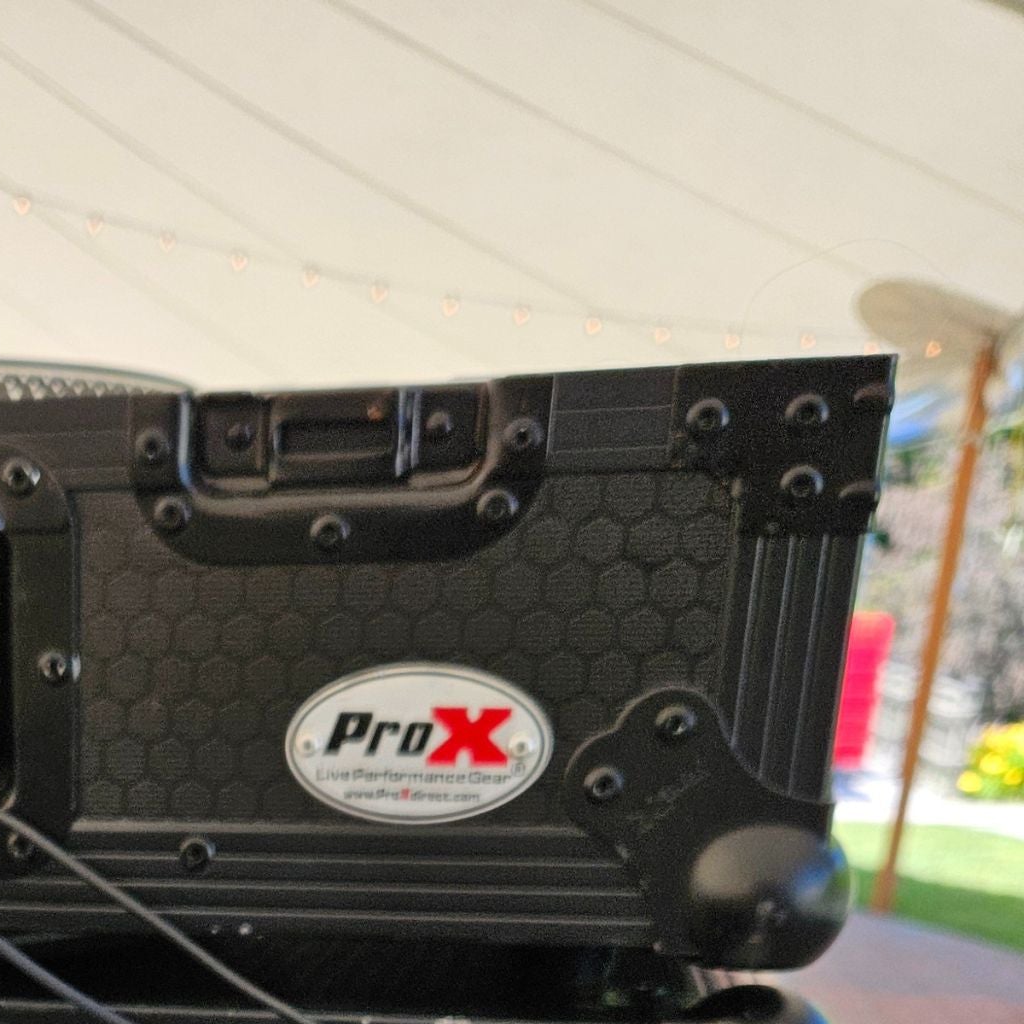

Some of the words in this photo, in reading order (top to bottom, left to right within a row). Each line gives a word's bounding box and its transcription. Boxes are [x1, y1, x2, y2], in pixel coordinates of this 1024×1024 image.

[323, 706, 512, 766] ProX
[316, 768, 350, 783] Live
[352, 769, 466, 785] Performance
[468, 770, 512, 786] Gear
